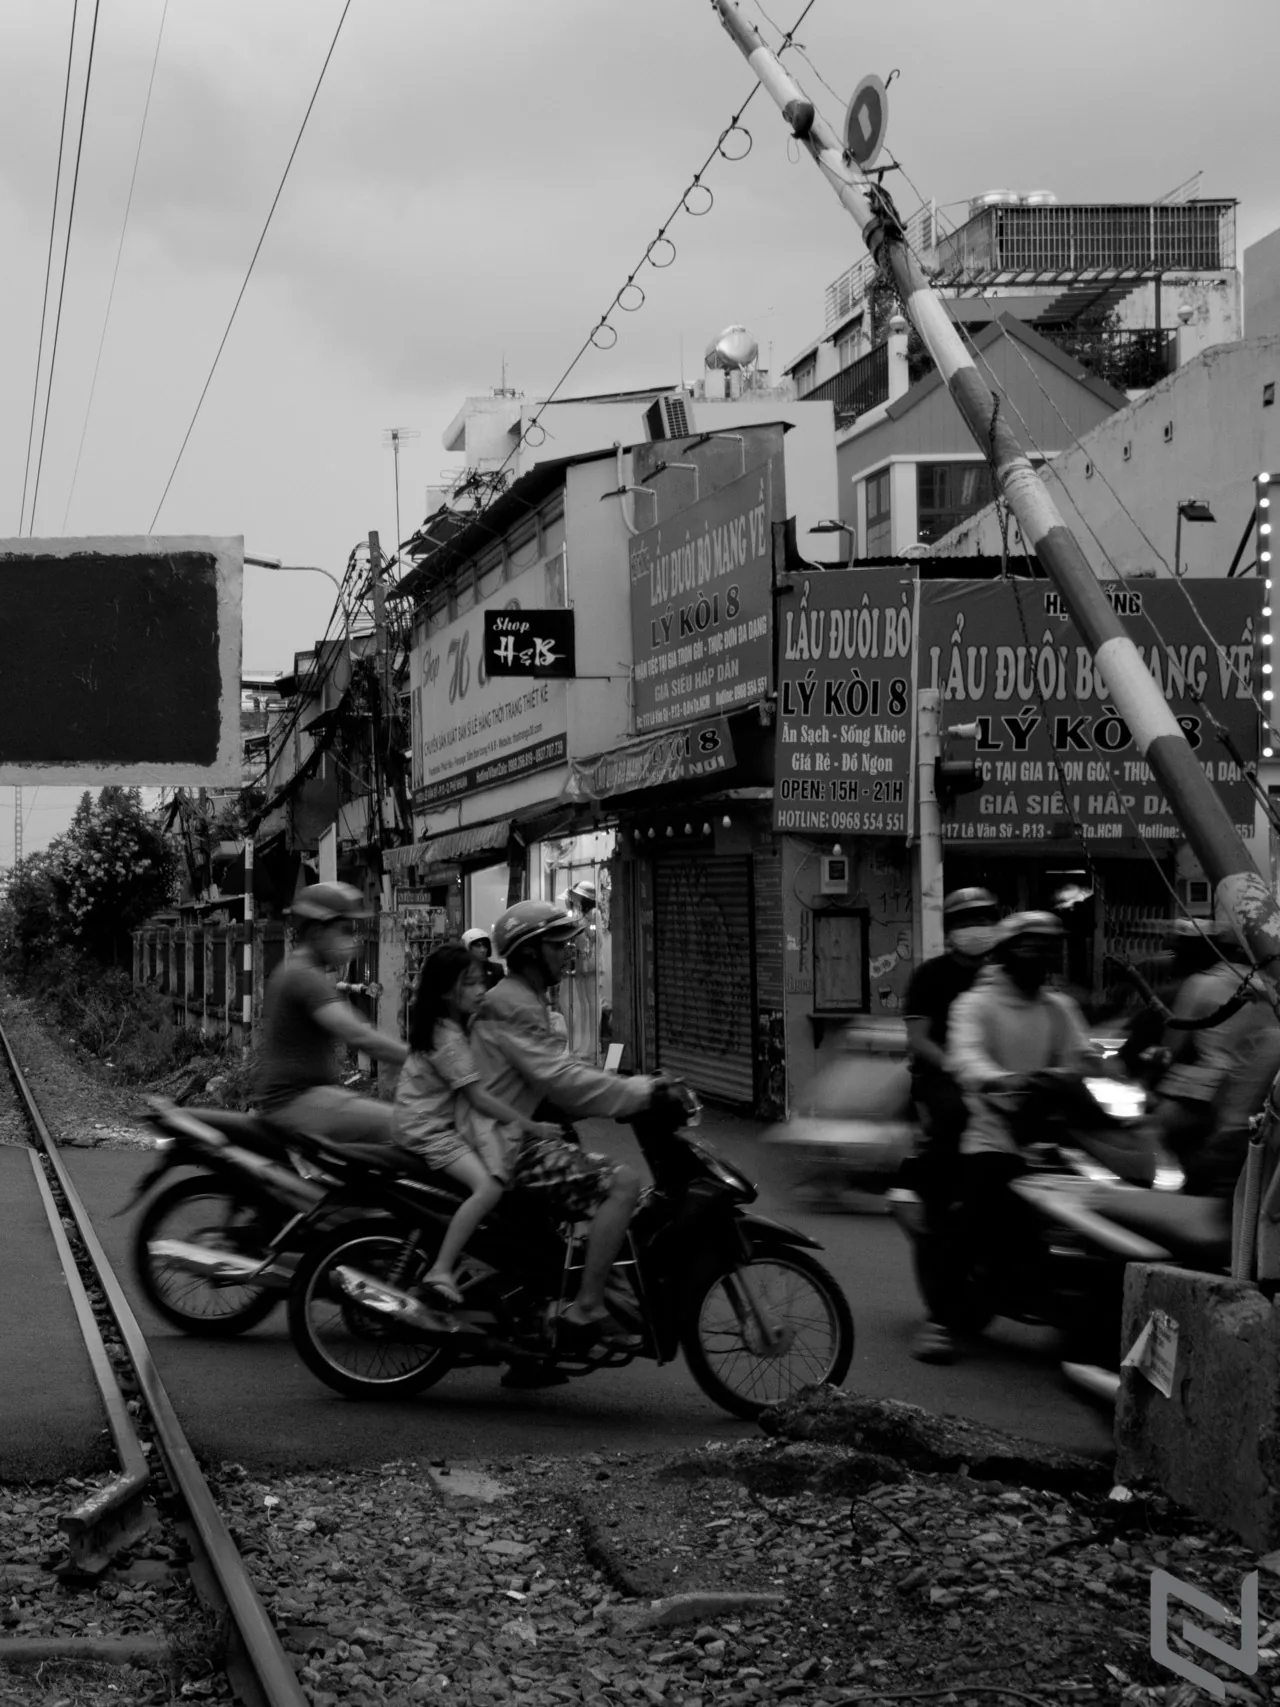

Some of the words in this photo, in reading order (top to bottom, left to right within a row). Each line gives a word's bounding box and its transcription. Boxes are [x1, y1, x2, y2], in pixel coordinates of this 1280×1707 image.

[712, 514, 747, 578] MANG
[748, 477, 766, 560] VỀ
[492, 616, 530, 634] Shop
[650, 602, 674, 650] LÝ
[680, 590, 719, 639] KÒI
[725, 584, 740, 620] 8
[785, 580, 825, 660] LẨU
[828, 592, 880, 659] ĐUÔI
[883, 591, 911, 658] BÒ
[930, 612, 988, 701] LẨU
[994, 629, 1068, 700] ĐUÔI
[1137, 644, 1208, 700] ANG
[1216, 616, 1254, 700] VỀ
[781, 668, 818, 717] LÝ
[823, 667, 880, 717] KÒI
[888, 677, 908, 718] 8
[698, 728, 721, 753] 8
[781, 721, 797, 743] Ăn
[800, 724, 830, 747] Sạch
[840, 723, 871, 747] Sống
[873, 723, 906, 744] Khỏe
[975, 705, 1041, 751] LÝ
[688, 754, 726, 775] NƠI
[791, 752, 811, 772] Giá
[815, 751, 831, 772] Rẻ
[841, 751, 858, 772] Đồ
[861, 752, 893, 775] Ngon
[995, 761, 1016, 786] TẠI
[1020, 761, 1043, 781] GIA
[781, 778, 826, 800] OPEN:
[829, 779, 859, 801] 15H
[873, 780, 904, 802] 21H
[979, 790, 1018, 815] GIÁ
[778, 810, 829, 828] HOTLINE:
[831, 811, 861, 829] 0968
[862, 812, 884, 831] 554
[886, 813, 904, 831] 551
[962, 822, 974, 838] Lê
[977, 822, 996, 838] Văn
